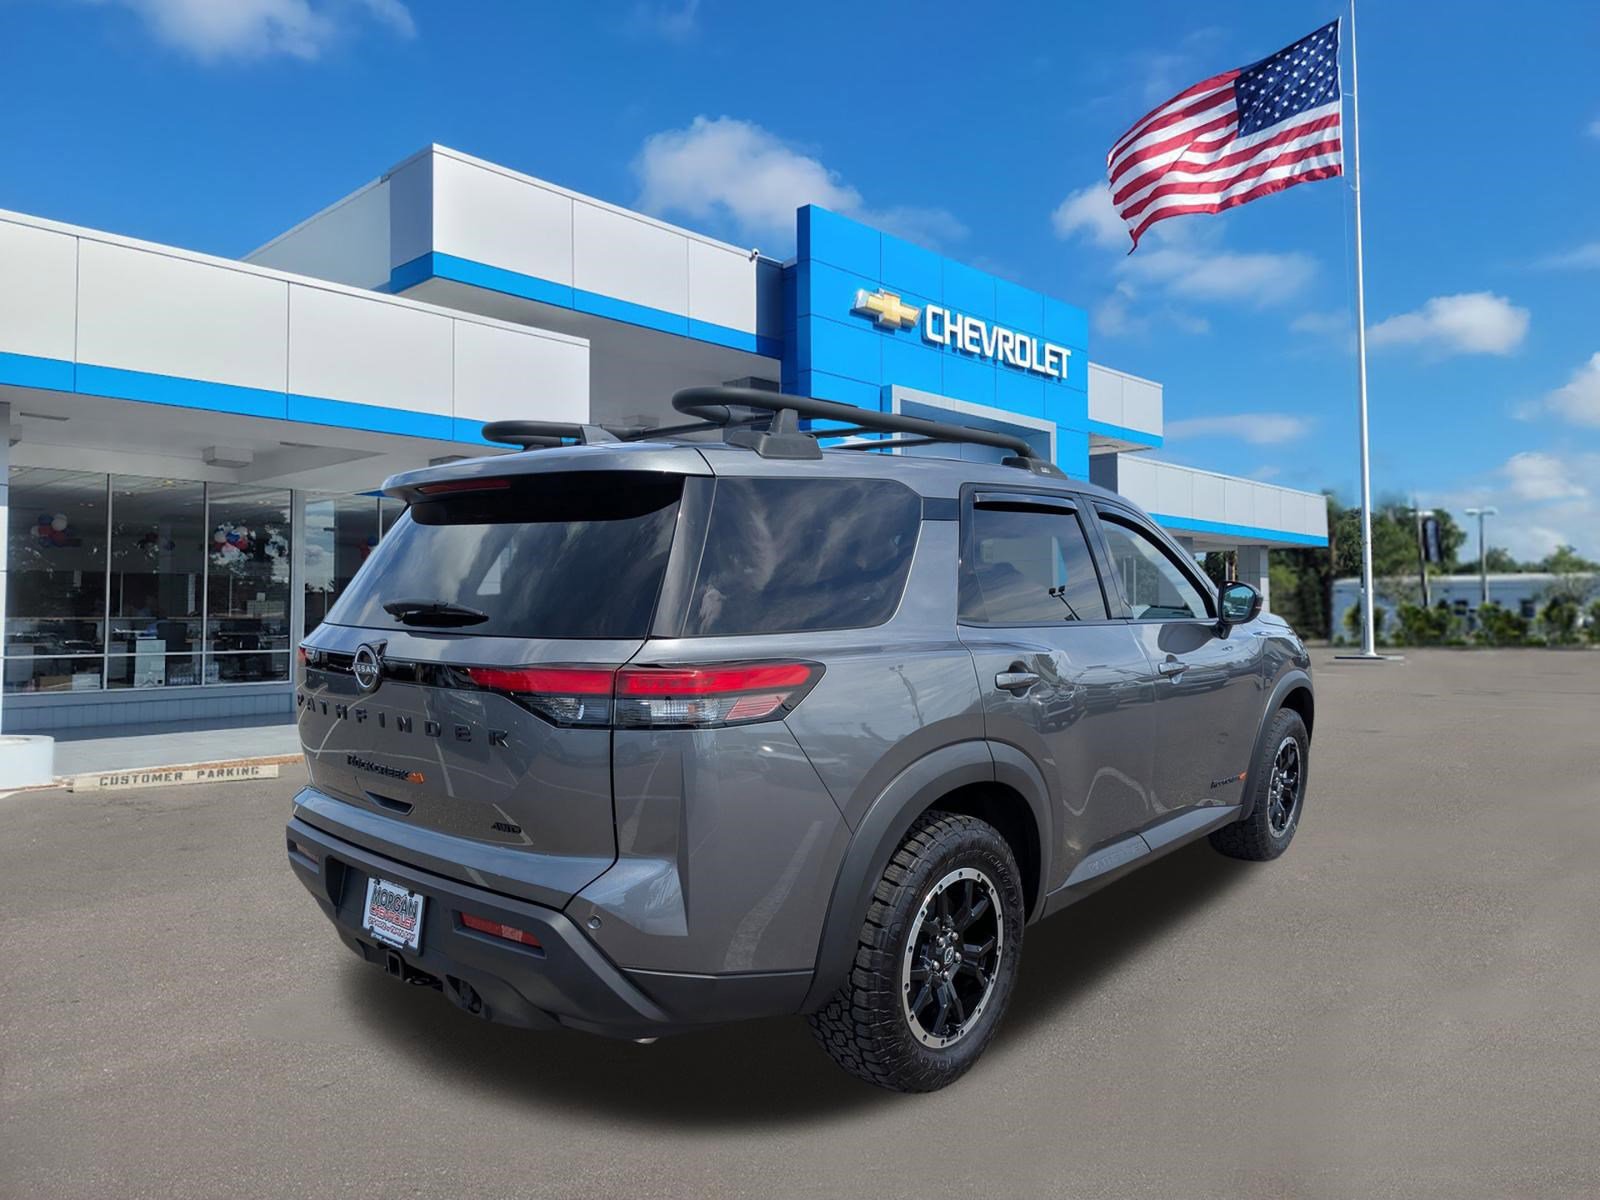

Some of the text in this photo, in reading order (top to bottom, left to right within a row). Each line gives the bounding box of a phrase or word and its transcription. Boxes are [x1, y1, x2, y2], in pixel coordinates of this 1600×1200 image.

[925, 303, 1072, 379] CHEVROLET
[354, 663, 379, 674] SSAN
[297, 694, 510, 749] PATHFINDER
[99, 765, 260, 787] CUSTOMER PARKING
